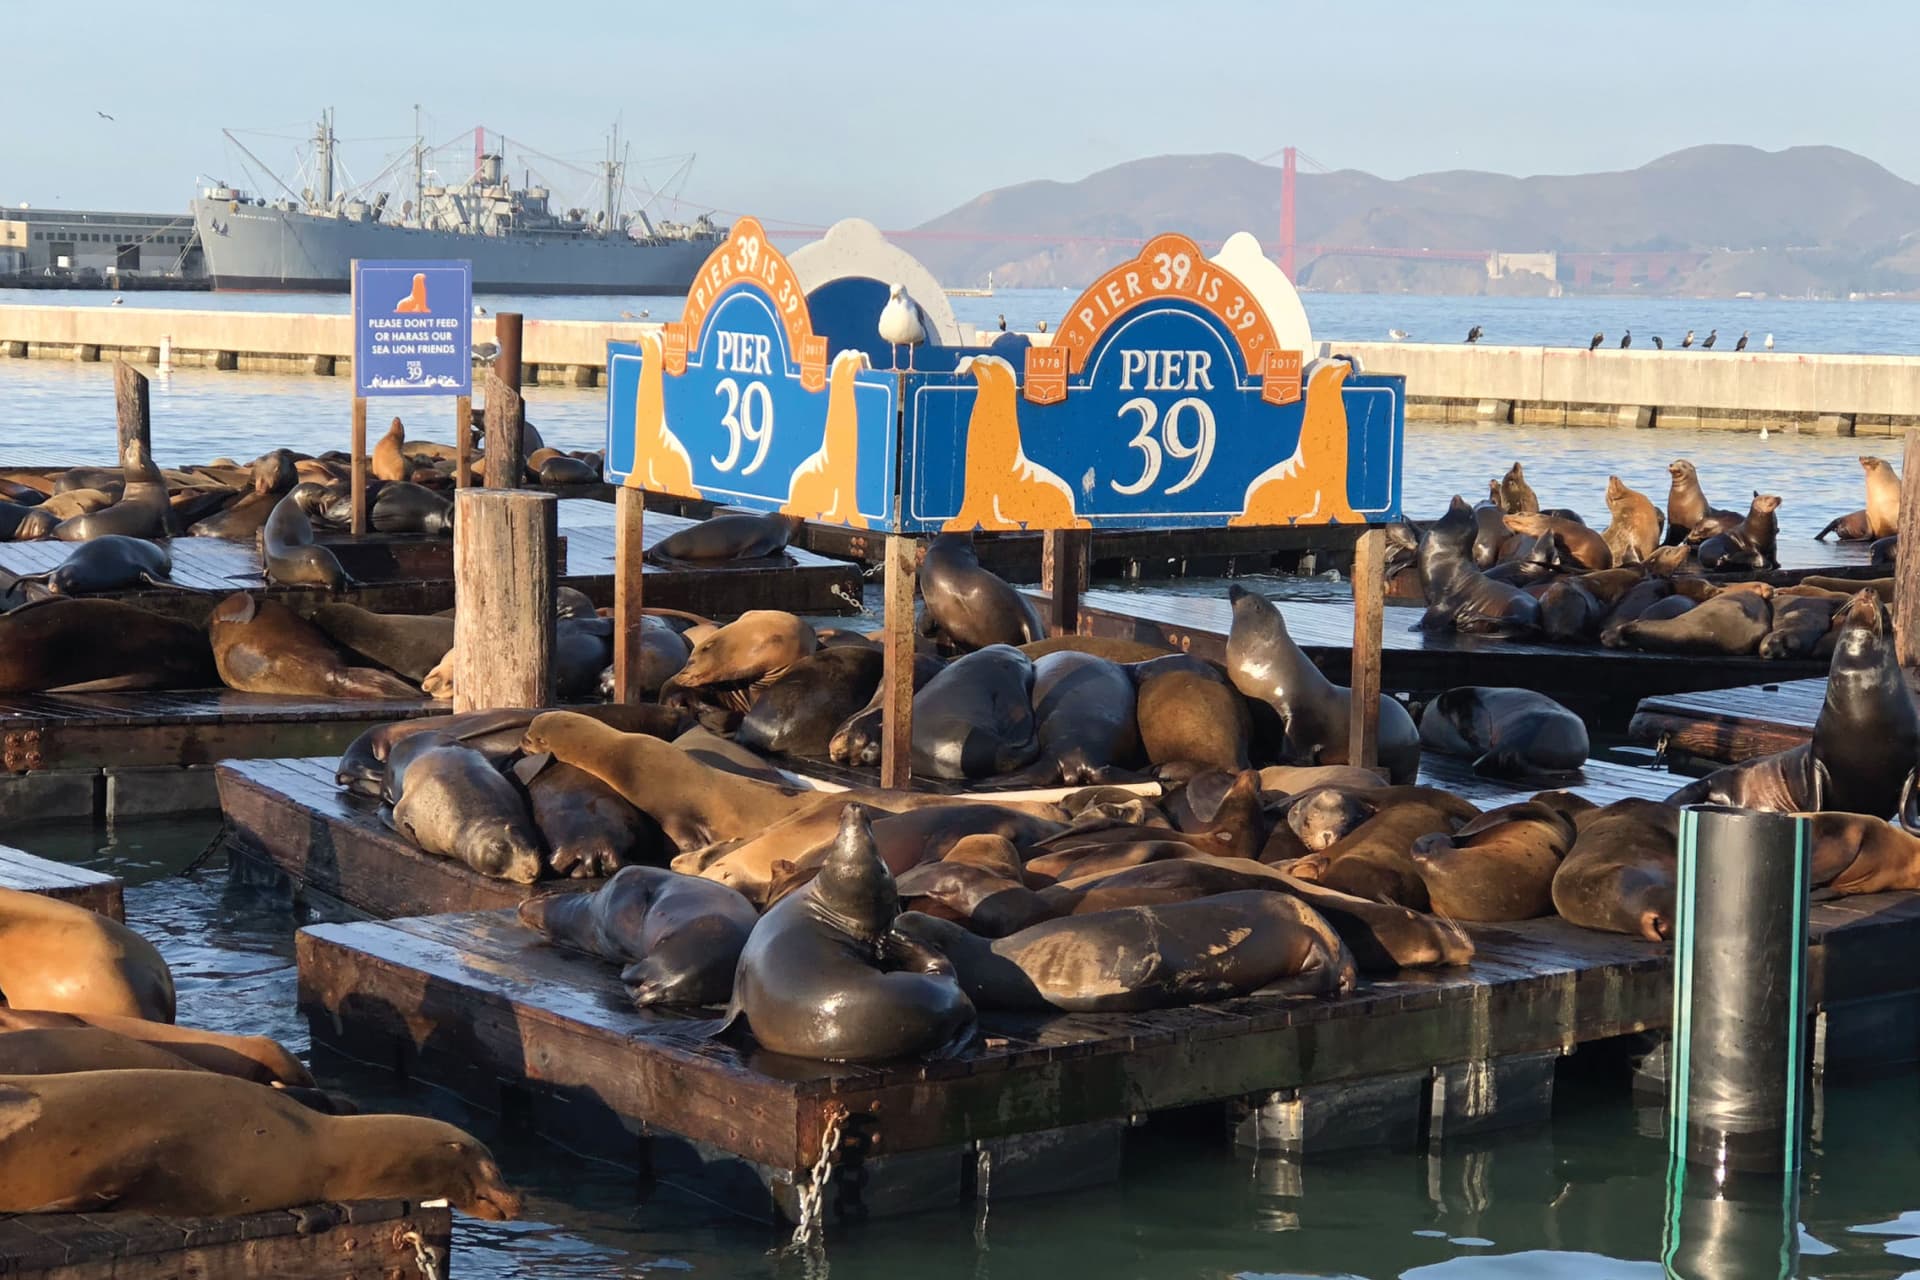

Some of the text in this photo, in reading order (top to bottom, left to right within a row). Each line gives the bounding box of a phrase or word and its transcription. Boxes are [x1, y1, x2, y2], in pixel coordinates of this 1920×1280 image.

[695, 235, 798, 313] PIER 39 IS 39
[1078, 252, 1256, 333] PIER 39 IS 39
[368, 319, 458, 328] PLEASE DON'T FEED
[374, 332, 453, 341] OR HARASS OUR
[372, 345, 456, 354] SEA LION FRIENDS
[716, 330, 772, 375] PIER
[406, 367, 422, 380] 39
[1032, 358, 1060, 369] 1978
[1119, 349, 1215, 391] PIER
[1270, 358, 1298, 369] 2017
[710, 377, 774, 476] 39
[1110, 397, 1216, 495] 39
